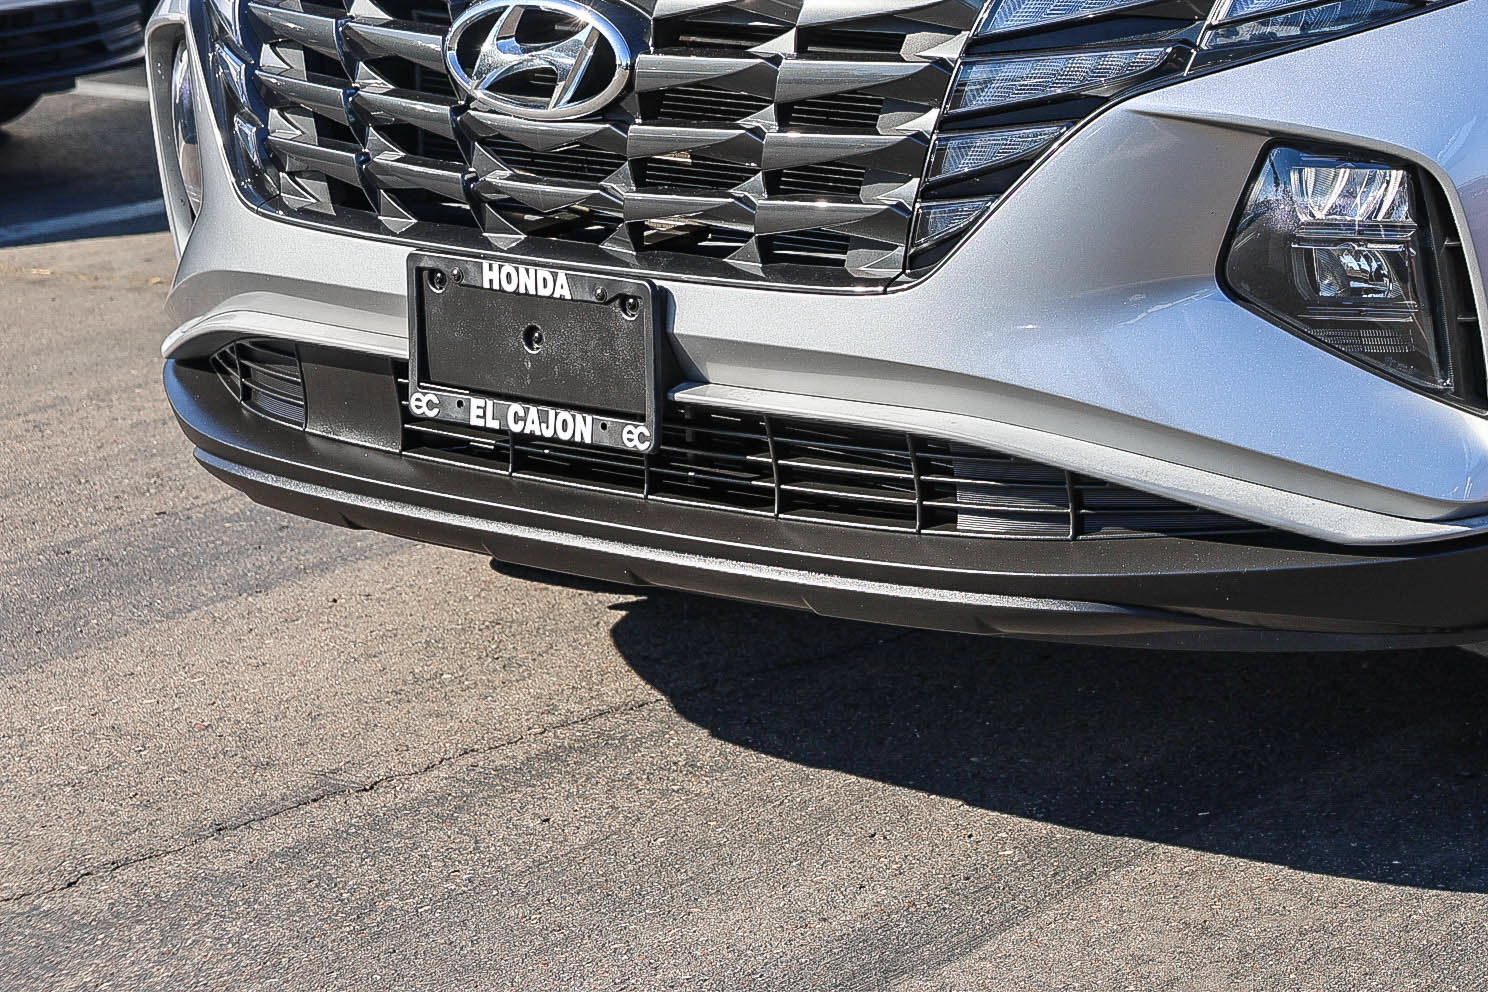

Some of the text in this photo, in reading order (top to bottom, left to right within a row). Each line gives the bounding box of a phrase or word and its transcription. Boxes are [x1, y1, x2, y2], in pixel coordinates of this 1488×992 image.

[482, 261, 572, 300] HONDA
[469, 397, 595, 444] EL CAJON
